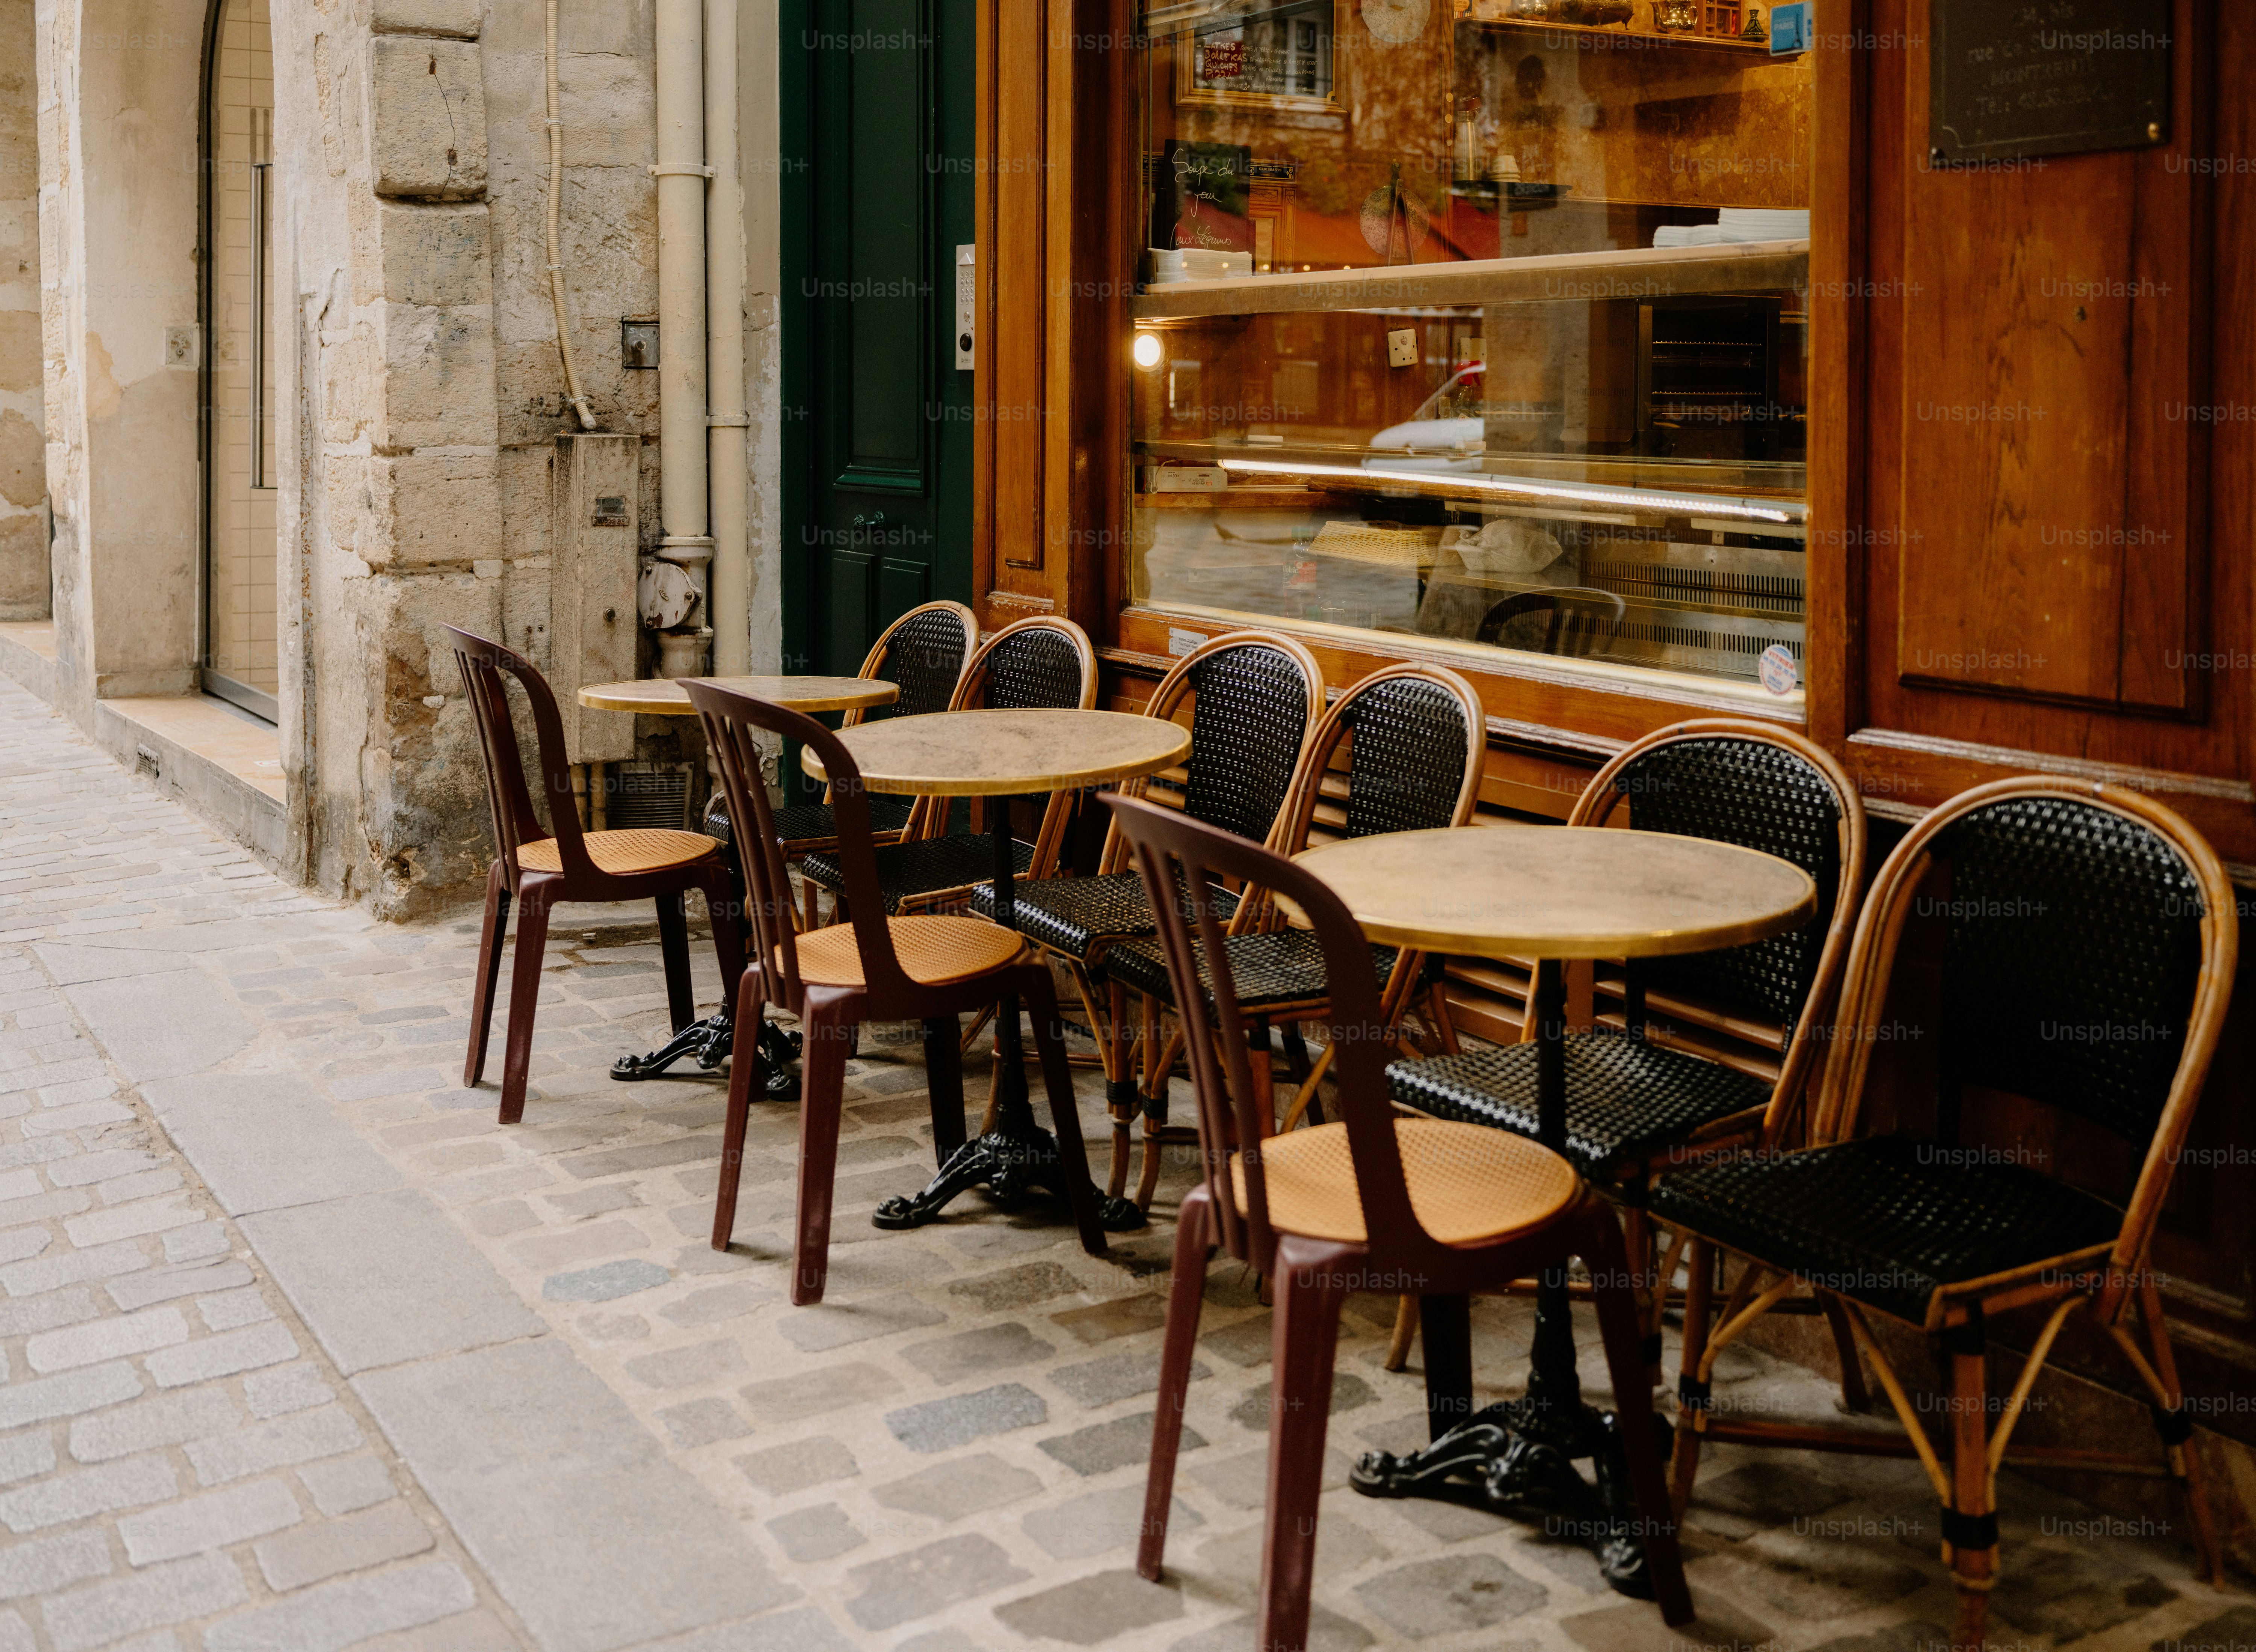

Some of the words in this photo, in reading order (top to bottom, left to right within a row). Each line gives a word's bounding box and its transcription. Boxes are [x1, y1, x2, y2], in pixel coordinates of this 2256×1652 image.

[1774, 21, 1794, 31] PARIS
[1203, 37, 1236, 51] LATKES
[1205, 49, 1248, 62] BORREKAS
[1172, 148, 1214, 186] Soupe
[1217, 158, 1234, 176] du
[1190, 191, 1222, 217] jour
[1768, 649, 1794, 671] VITRIER
